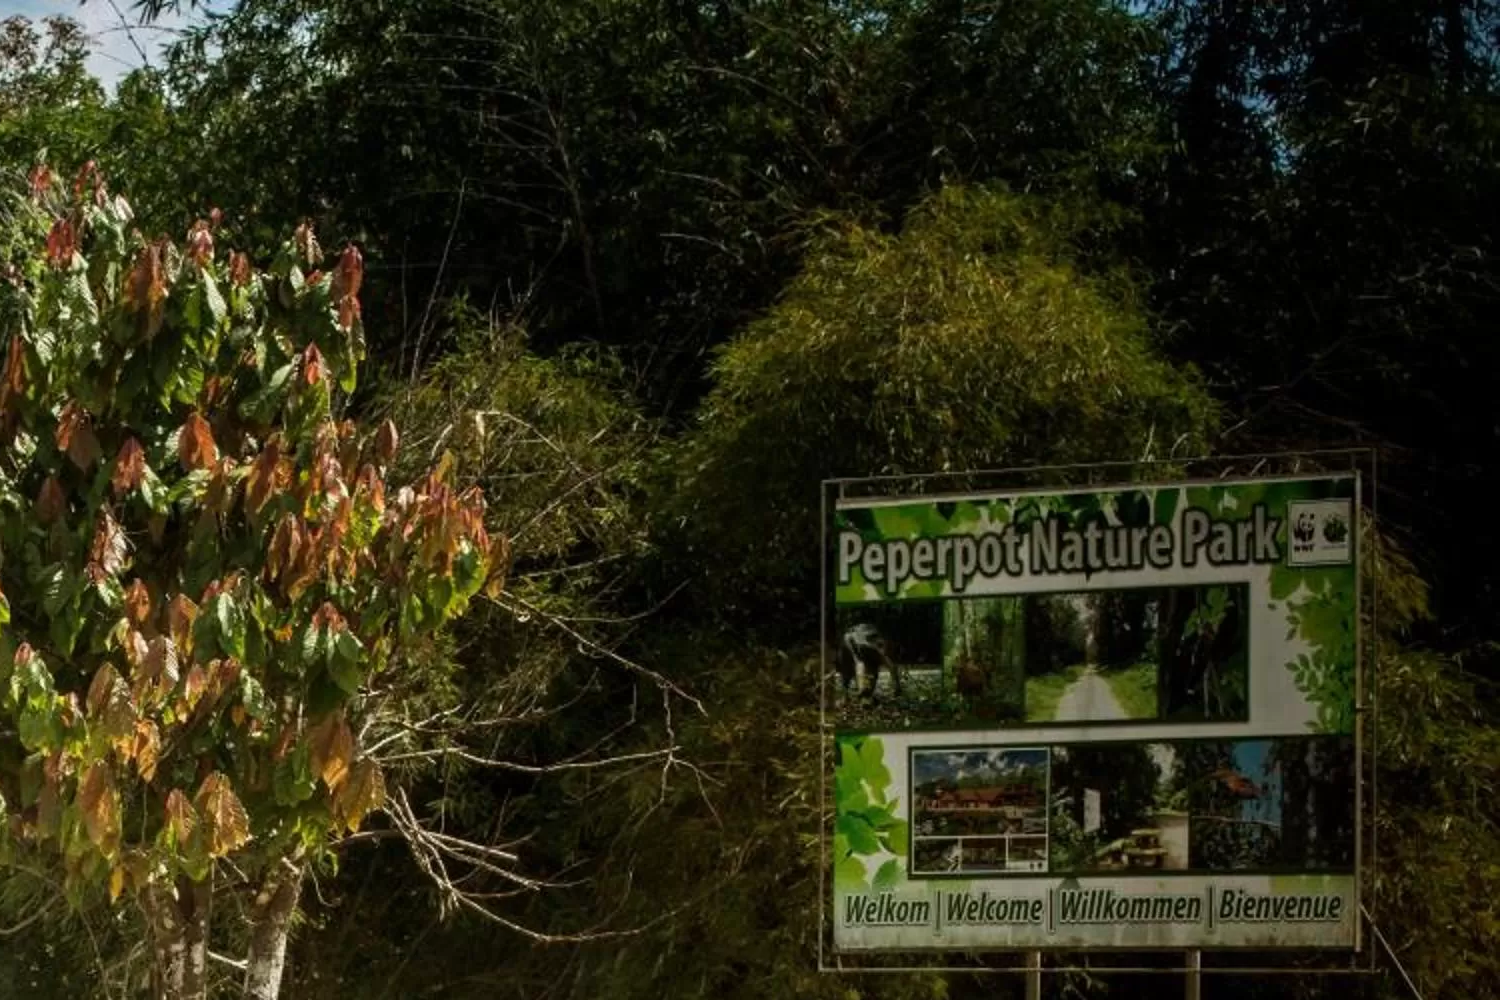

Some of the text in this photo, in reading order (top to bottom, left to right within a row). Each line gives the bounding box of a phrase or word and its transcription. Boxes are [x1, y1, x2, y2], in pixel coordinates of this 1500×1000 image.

[838, 503, 1280, 594] Peperpot Nature Park
[845, 888, 1341, 923] Welkom Welcome Willkommen Bienvenue
